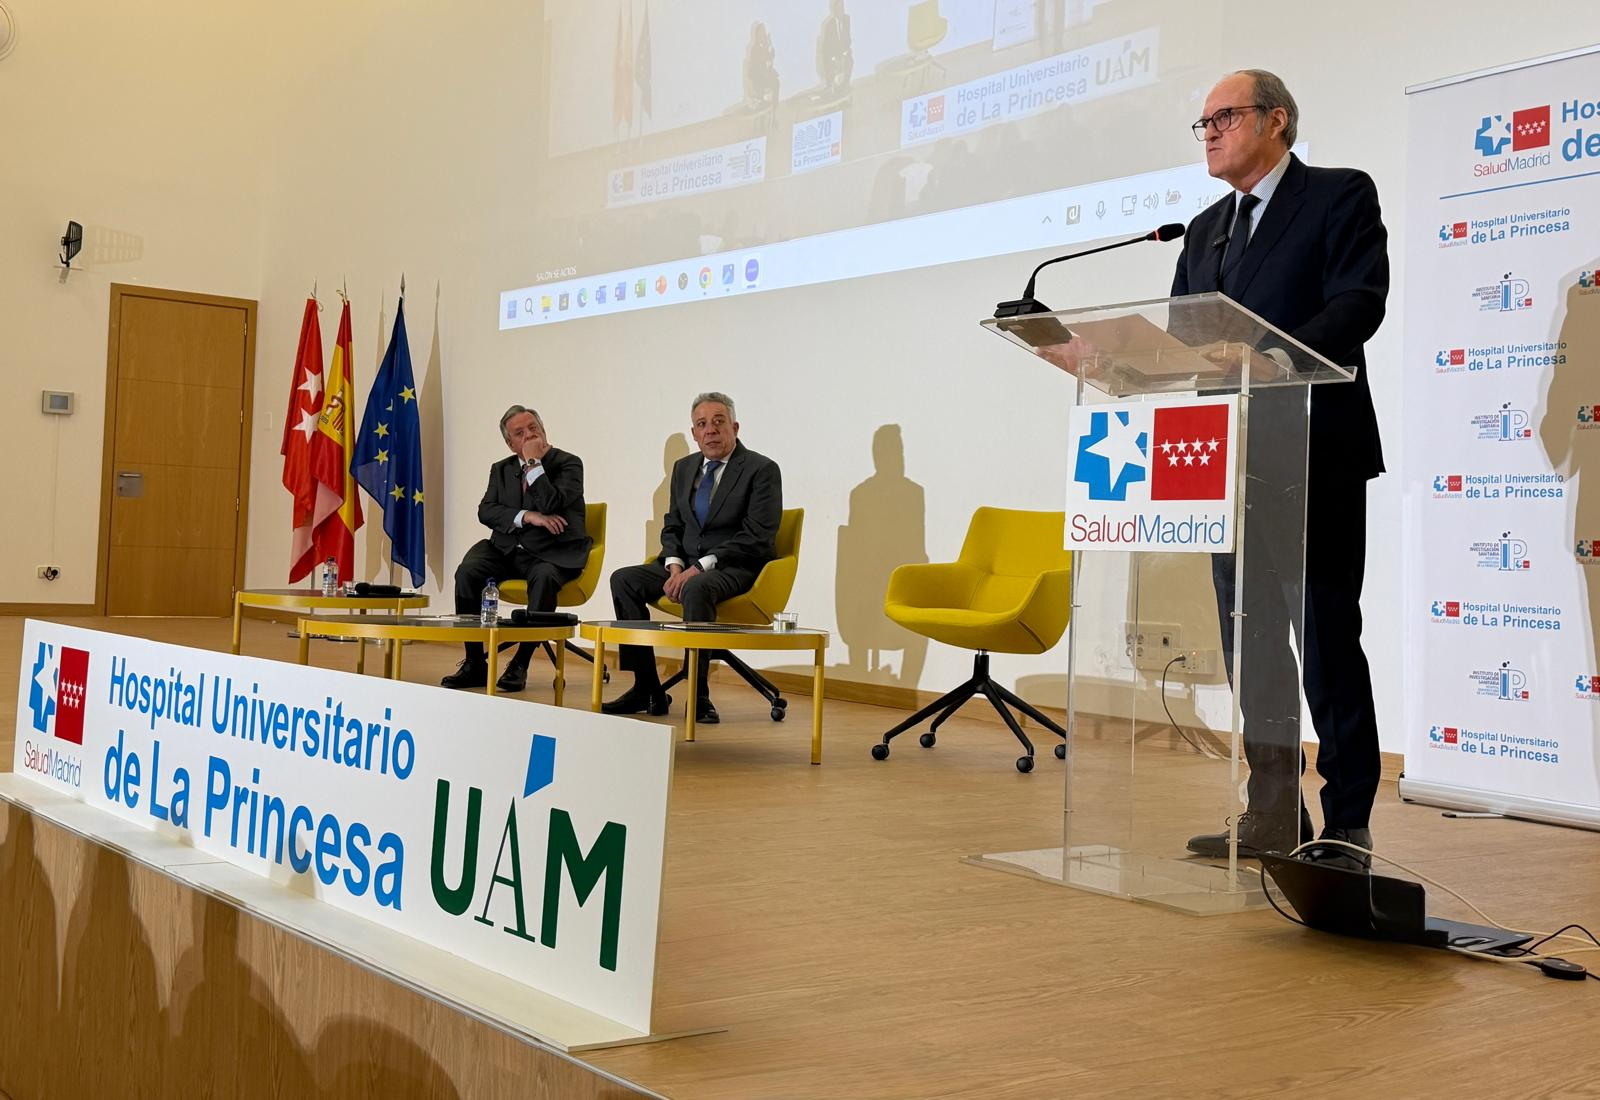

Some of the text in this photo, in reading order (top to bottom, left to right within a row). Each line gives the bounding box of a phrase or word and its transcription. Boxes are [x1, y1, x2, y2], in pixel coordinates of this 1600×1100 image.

[958, 54, 1090, 105] Hospital Universitario
[956, 78, 1088, 127] de La Princesa
[817, 118, 832, 139] 70
[1562, 128, 1600, 163] de
[641, 164, 671, 178] Hospital
[672, 153, 724, 174] Universitario
[1474, 152, 1550, 177] SaludMadrid
[641, 171, 722, 197] de La Princesa
[1471, 208, 1570, 230] Hospital Universitario
[1471, 221, 1570, 244] de La Princesa
[1468, 340, 1567, 359] Hospital Universitario
[1468, 353, 1567, 371] de La Princesa
[1466, 473, 1564, 486] Hospital Universitario
[1466, 486, 1563, 499] de La Princesa
[1071, 514, 1225, 545] SaludMadrid
[1463, 602, 1561, 616] Hospital Universitario
[1463, 613, 1561, 630] de La Princesa
[110, 655, 416, 780] Hospital Universitario
[1461, 729, 1559, 749] Hospital Universitario
[24, 740, 82, 788] SaludMadrid
[1461, 741, 1558, 764] de La Princesa
[104, 730, 404, 911] de La Princesa
